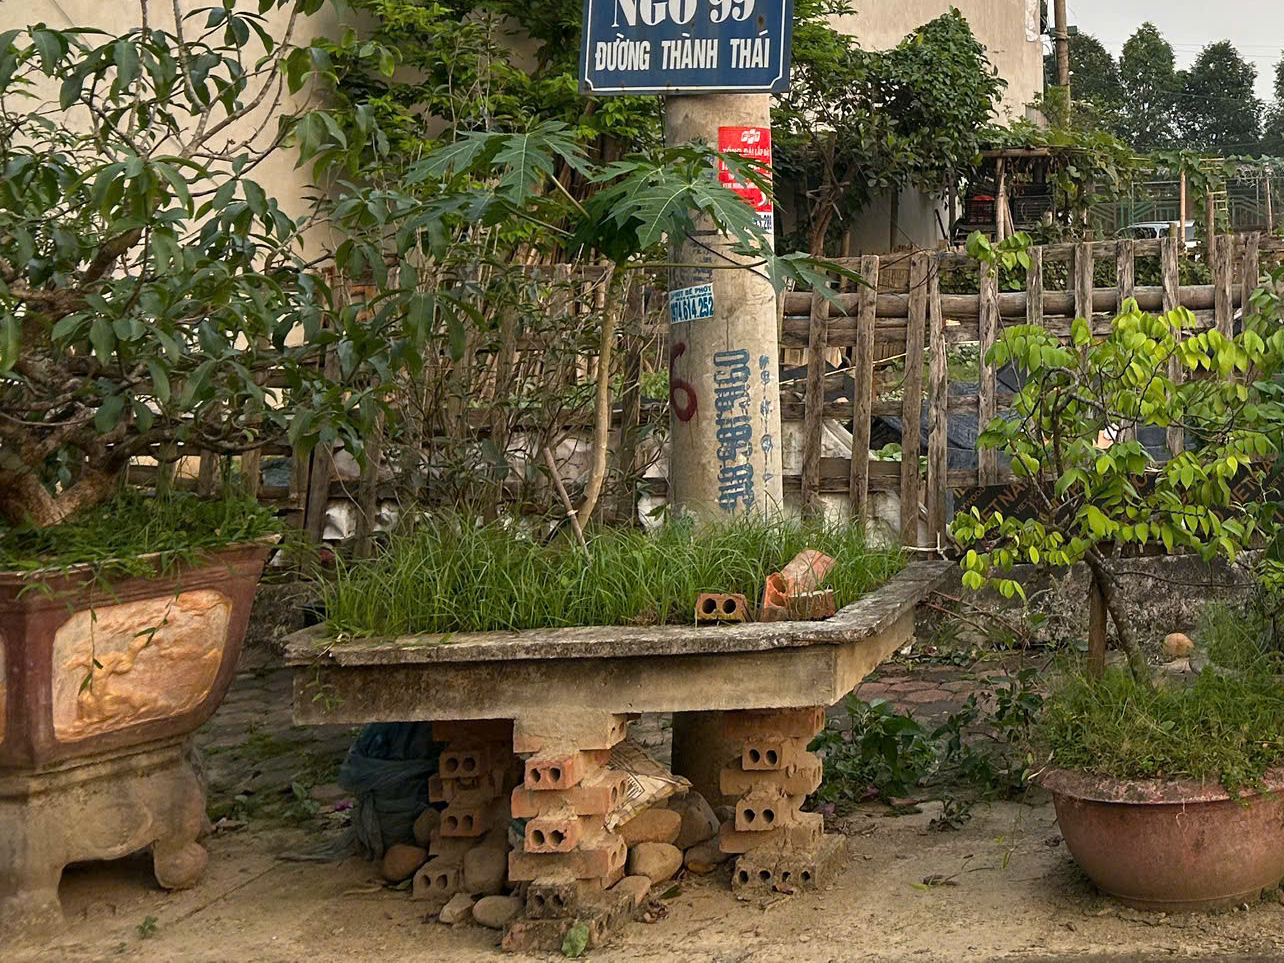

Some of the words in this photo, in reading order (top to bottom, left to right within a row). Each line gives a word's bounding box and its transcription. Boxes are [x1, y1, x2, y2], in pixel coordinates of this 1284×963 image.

[595, 33, 650, 71] ĐƯỜNG
[661, 33, 719, 70] THÀNH
[730, 29, 770, 69] THÁI
